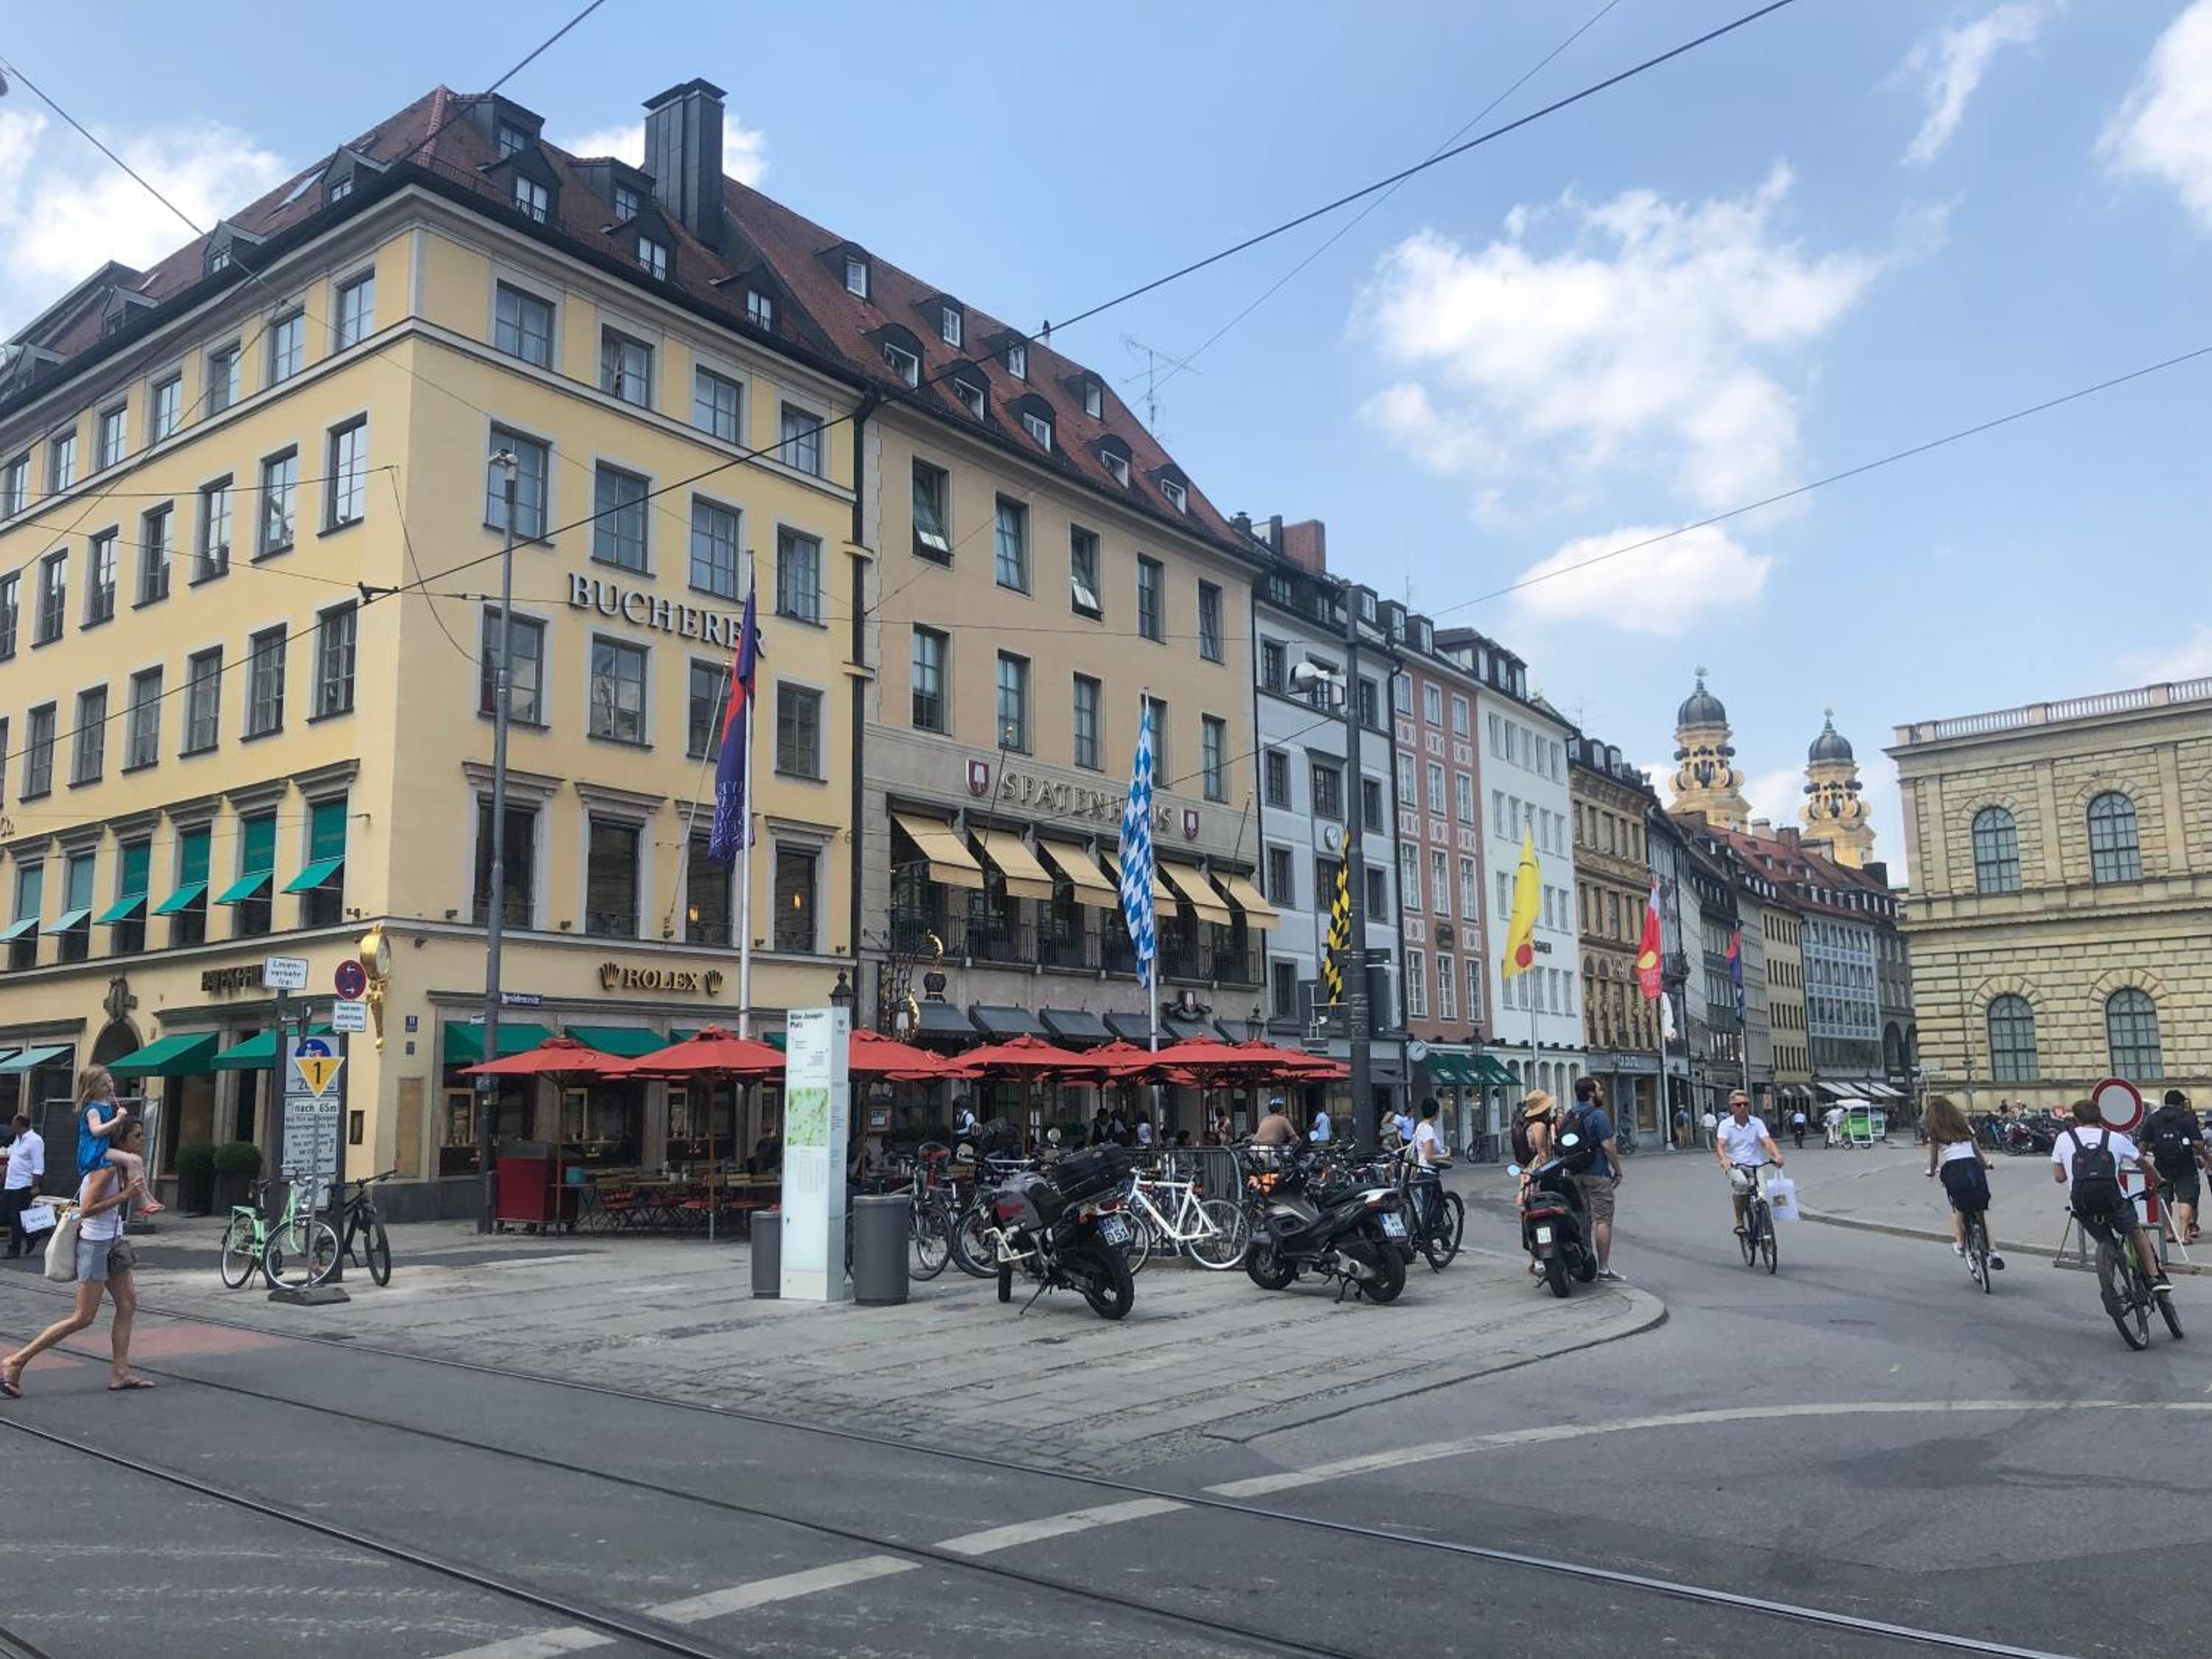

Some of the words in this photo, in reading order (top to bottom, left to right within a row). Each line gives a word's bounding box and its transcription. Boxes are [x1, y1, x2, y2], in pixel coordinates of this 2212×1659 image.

[568, 572, 766, 658] BUCHERER
[271, 969, 302, 978] verkehr
[625, 969, 701, 991] ROLEX
[314, 1062, 321, 1085] 1
[295, 1105, 315, 1113] nach
